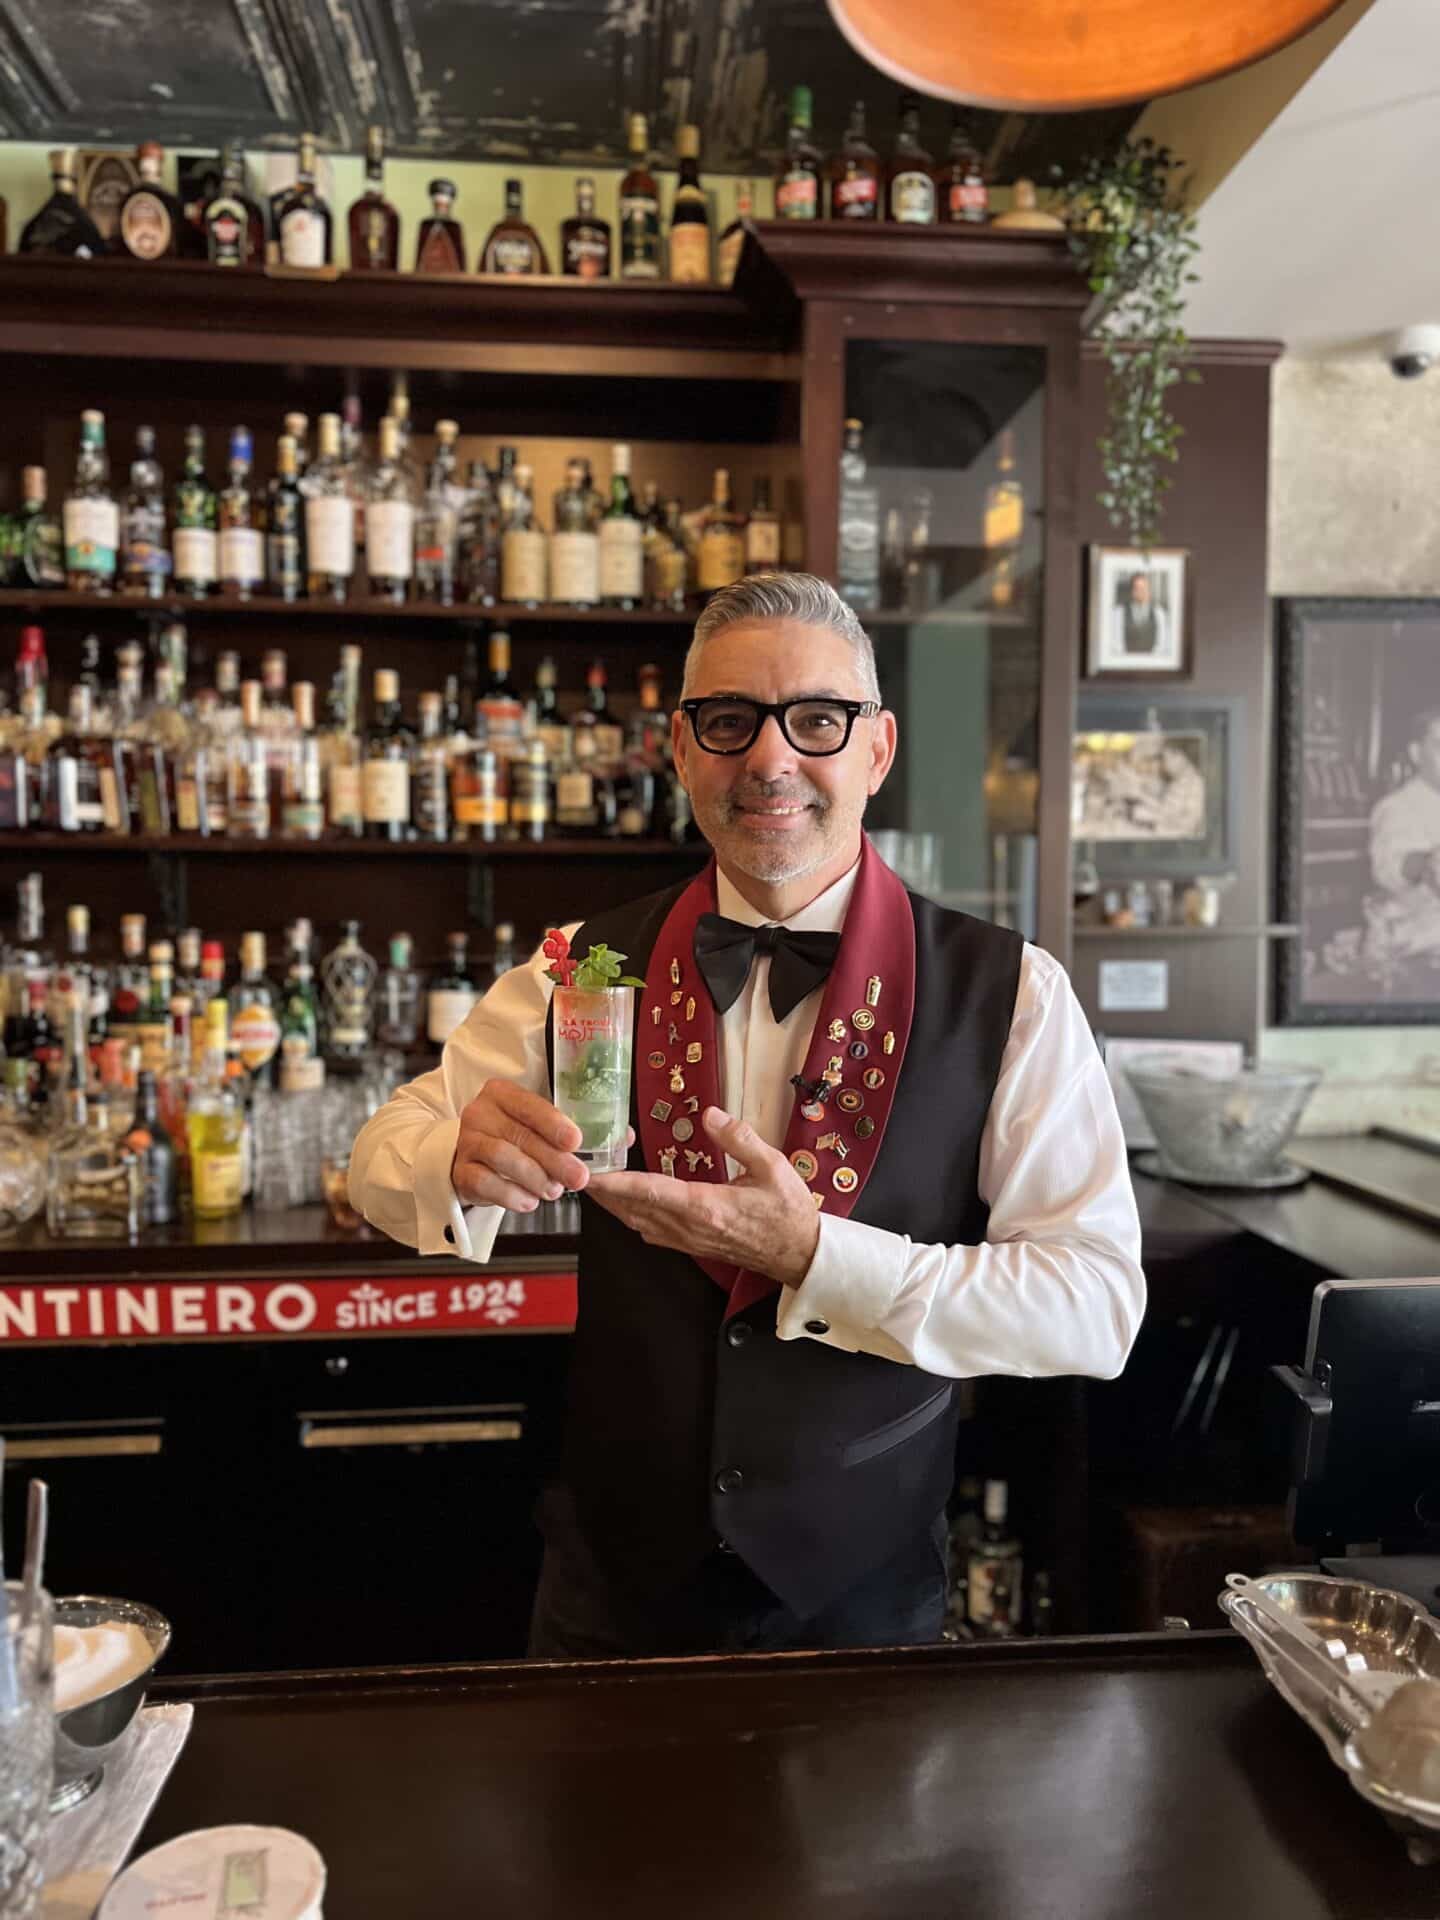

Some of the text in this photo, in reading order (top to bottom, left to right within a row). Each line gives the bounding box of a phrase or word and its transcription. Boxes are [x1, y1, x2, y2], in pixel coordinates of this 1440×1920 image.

[0, 1280, 525, 1337] NTINERO SINCE 1924
